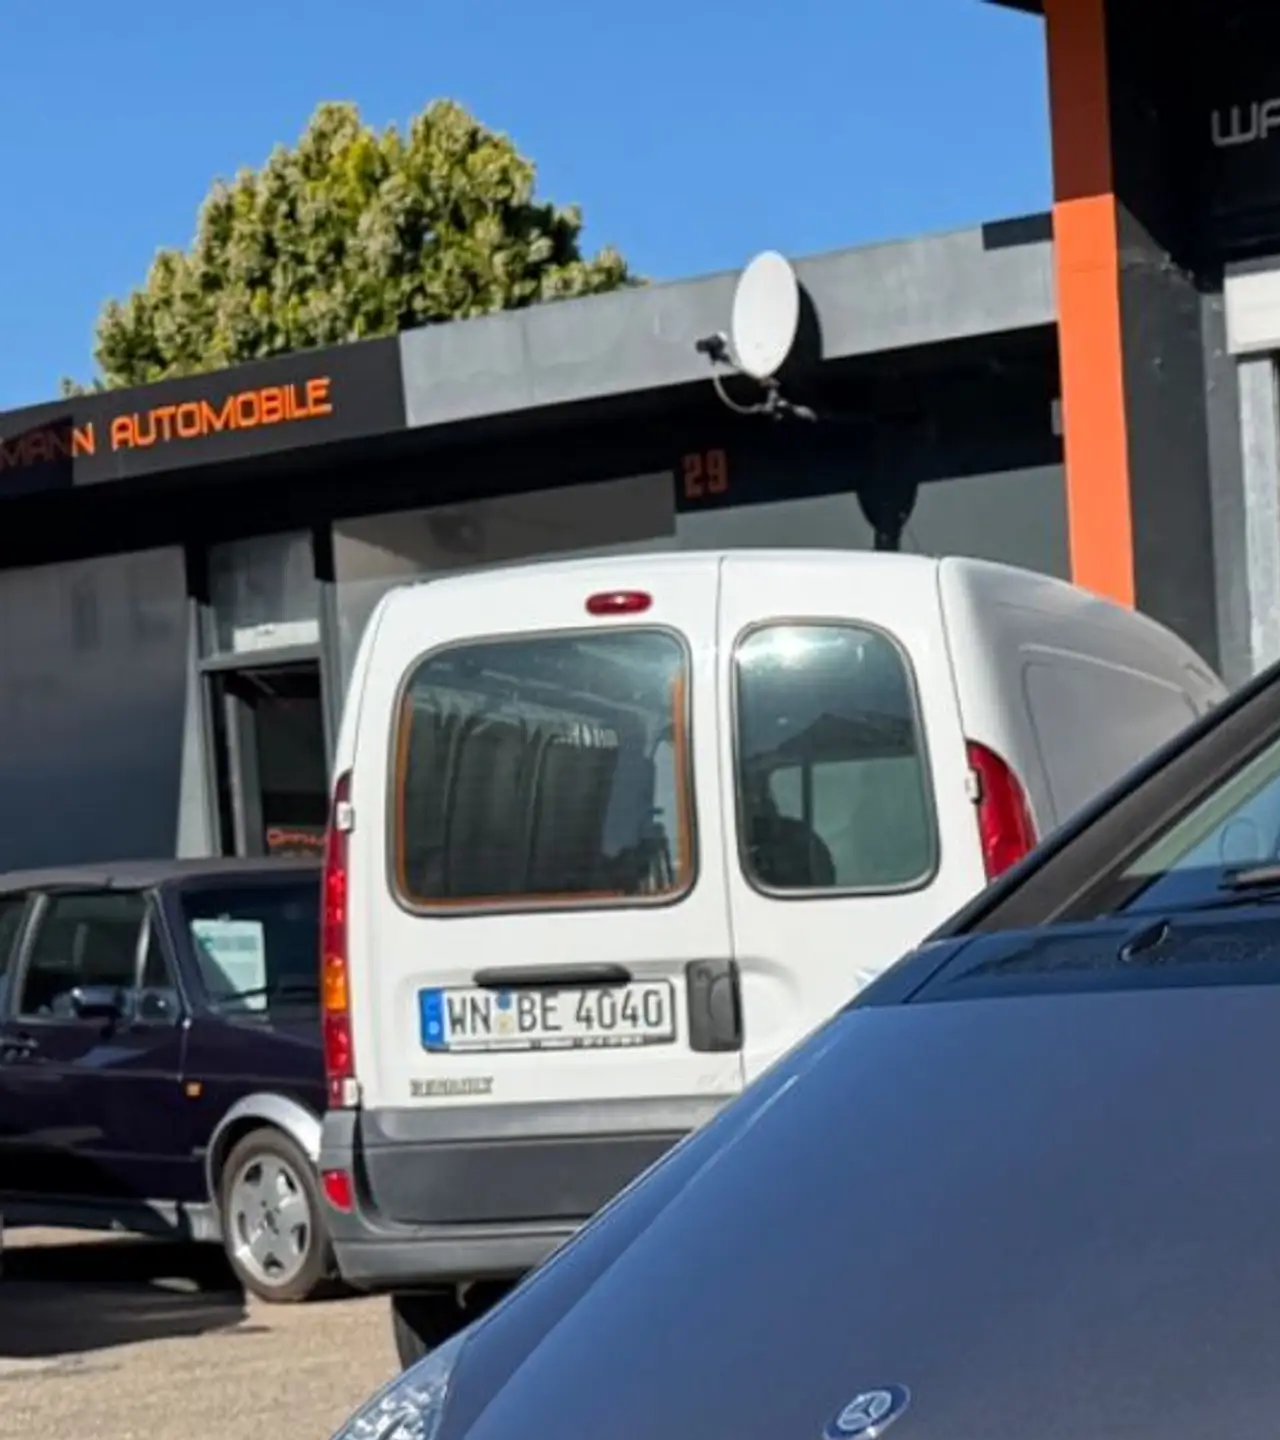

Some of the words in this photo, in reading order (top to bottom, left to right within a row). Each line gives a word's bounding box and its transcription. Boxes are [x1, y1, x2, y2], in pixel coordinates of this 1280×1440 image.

[110, 376, 334, 453] AUTOMOBILE
[681, 450, 729, 498] 29
[447, 995, 491, 1036] WN
[517, 992, 562, 1034] BE
[575, 987, 664, 1032] 4040
